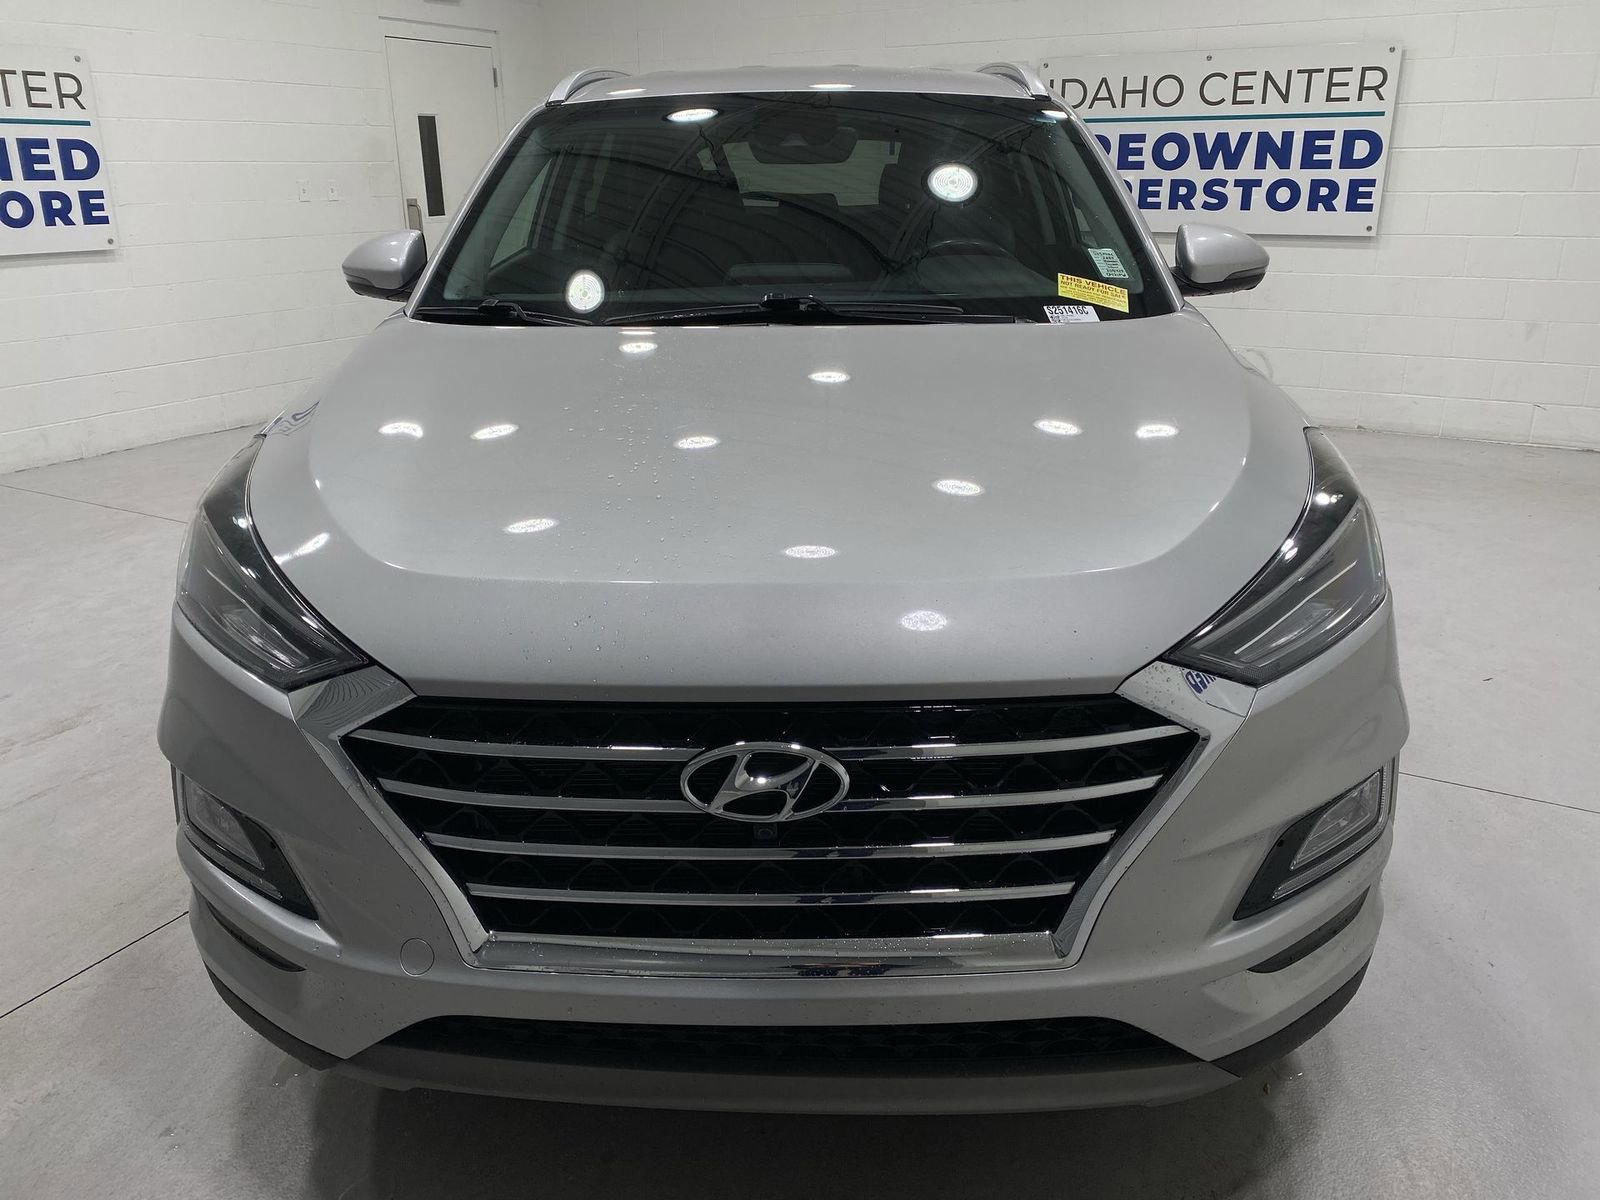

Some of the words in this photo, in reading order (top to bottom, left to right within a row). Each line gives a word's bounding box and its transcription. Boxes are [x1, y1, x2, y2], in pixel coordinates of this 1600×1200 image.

[1199, 65, 1389, 107] CENTER
[0, 137, 101, 181] ED
[1125, 178, 1377, 212] ERSTORE
[1060, 274, 1083, 284] THIS
[1085, 279, 1127, 295] VEHICLE
[1074, 283, 1095, 292] READY
[1096, 288, 1110, 296] FOR
